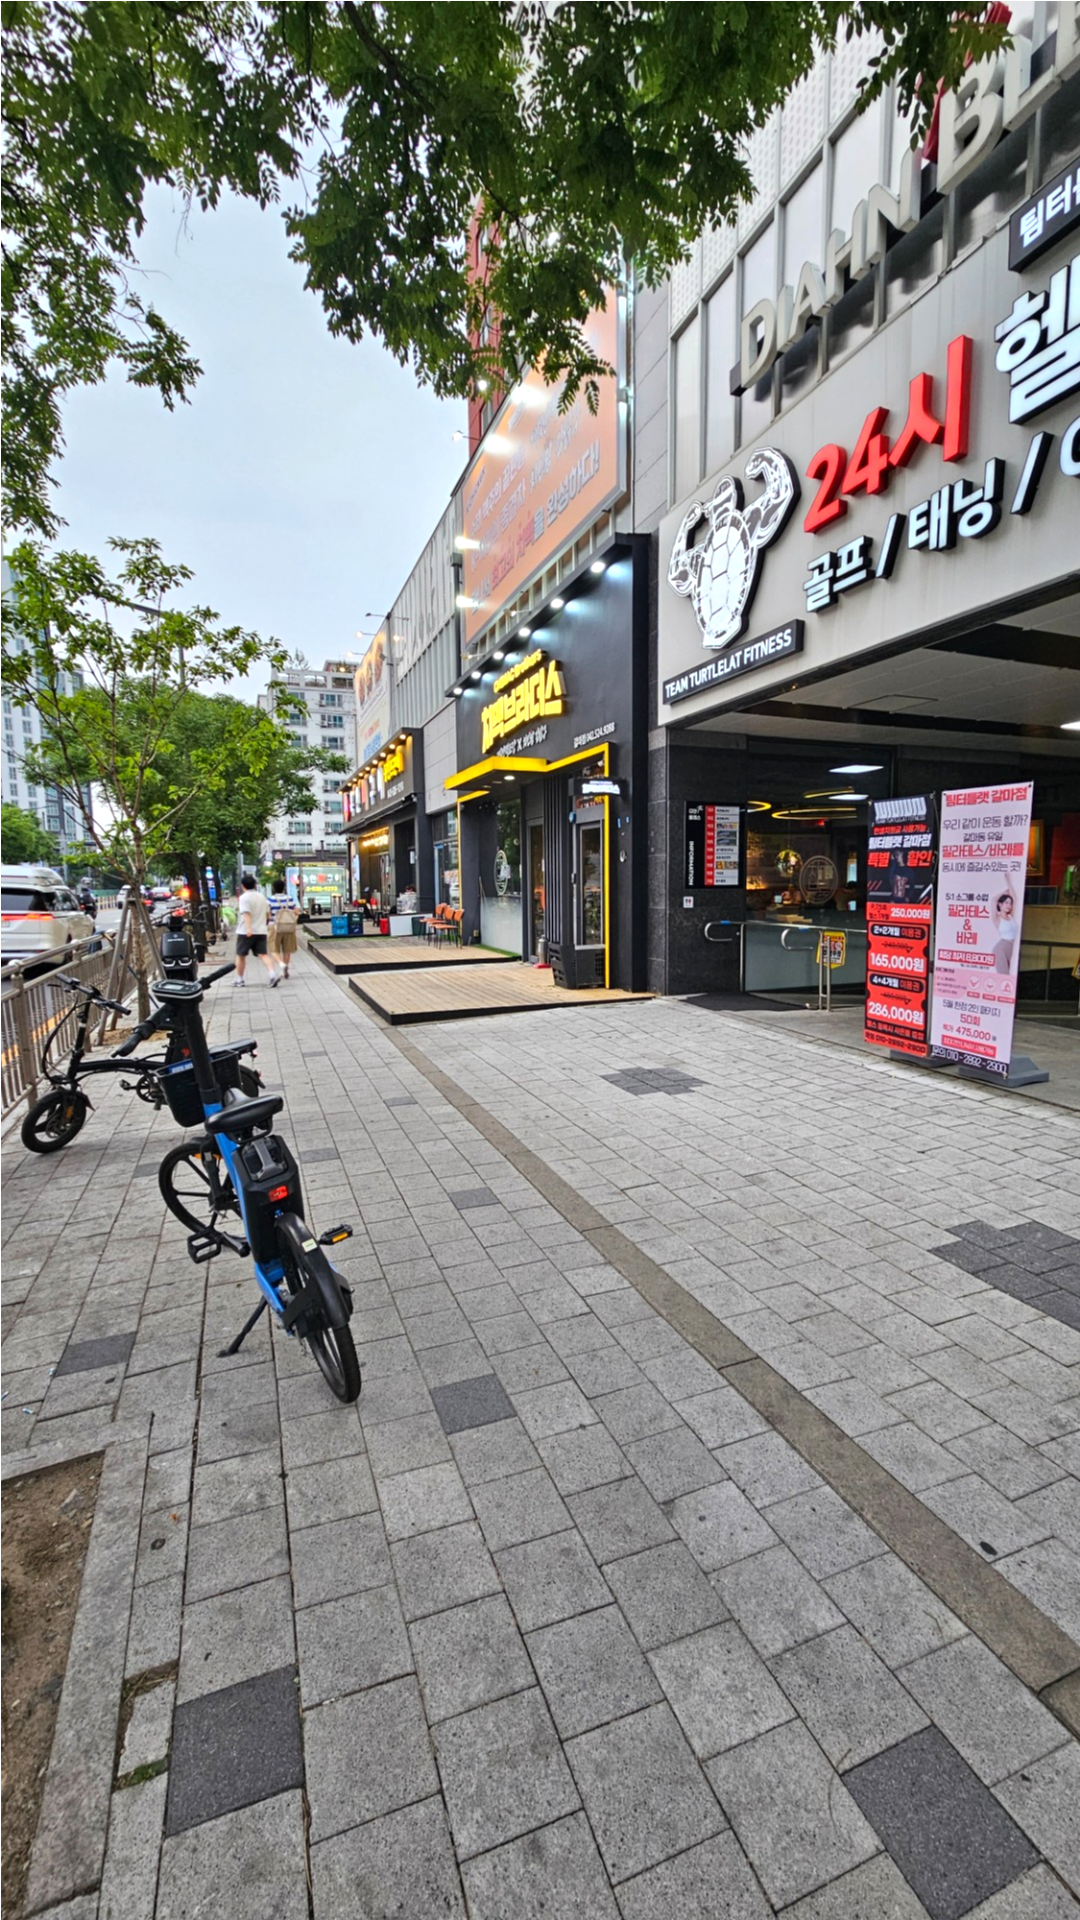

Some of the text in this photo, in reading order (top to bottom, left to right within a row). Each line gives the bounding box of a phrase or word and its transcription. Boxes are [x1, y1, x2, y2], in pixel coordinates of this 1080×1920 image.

[1020, 168, 1080, 248] 팀터
[804, 335, 973, 533] 24시
[547, 439, 600, 528] 완성하다!
[665, 629, 792, 698] TEAM TURTLELAT FITNESS
[946, 787, 1027, 807] 팀터틀랫 갈마점
[943, 814, 1028, 830] 우리 같이 운동 할까?
[903, 833, 932, 848] 갈마점
[963, 831, 1003, 842] 갈마동 유일
[868, 850, 933, 867] 특별 할인
[942, 862, 965, 873] 동시에
[975, 893, 989, 902] 수업
[948, 904, 990, 919] 필라테스
[963, 918, 972, 931] &
[901, 927, 922, 938] 이용권
[956, 931, 978, 945] 바레
[870, 952, 924, 973] 165,000원
[900, 980, 920, 991] 이용권
[868, 1001, 925, 1025] 286,000원
[943, 999, 953, 1008] 5월
[954, 1001, 967, 1012] 한정
[980, 1005, 1001, 1017] 패키지
[960, 1013, 980, 1026] 50회
[955, 1026, 991, 1041] 475,000
[933, 1045, 945, 1058] 문의
